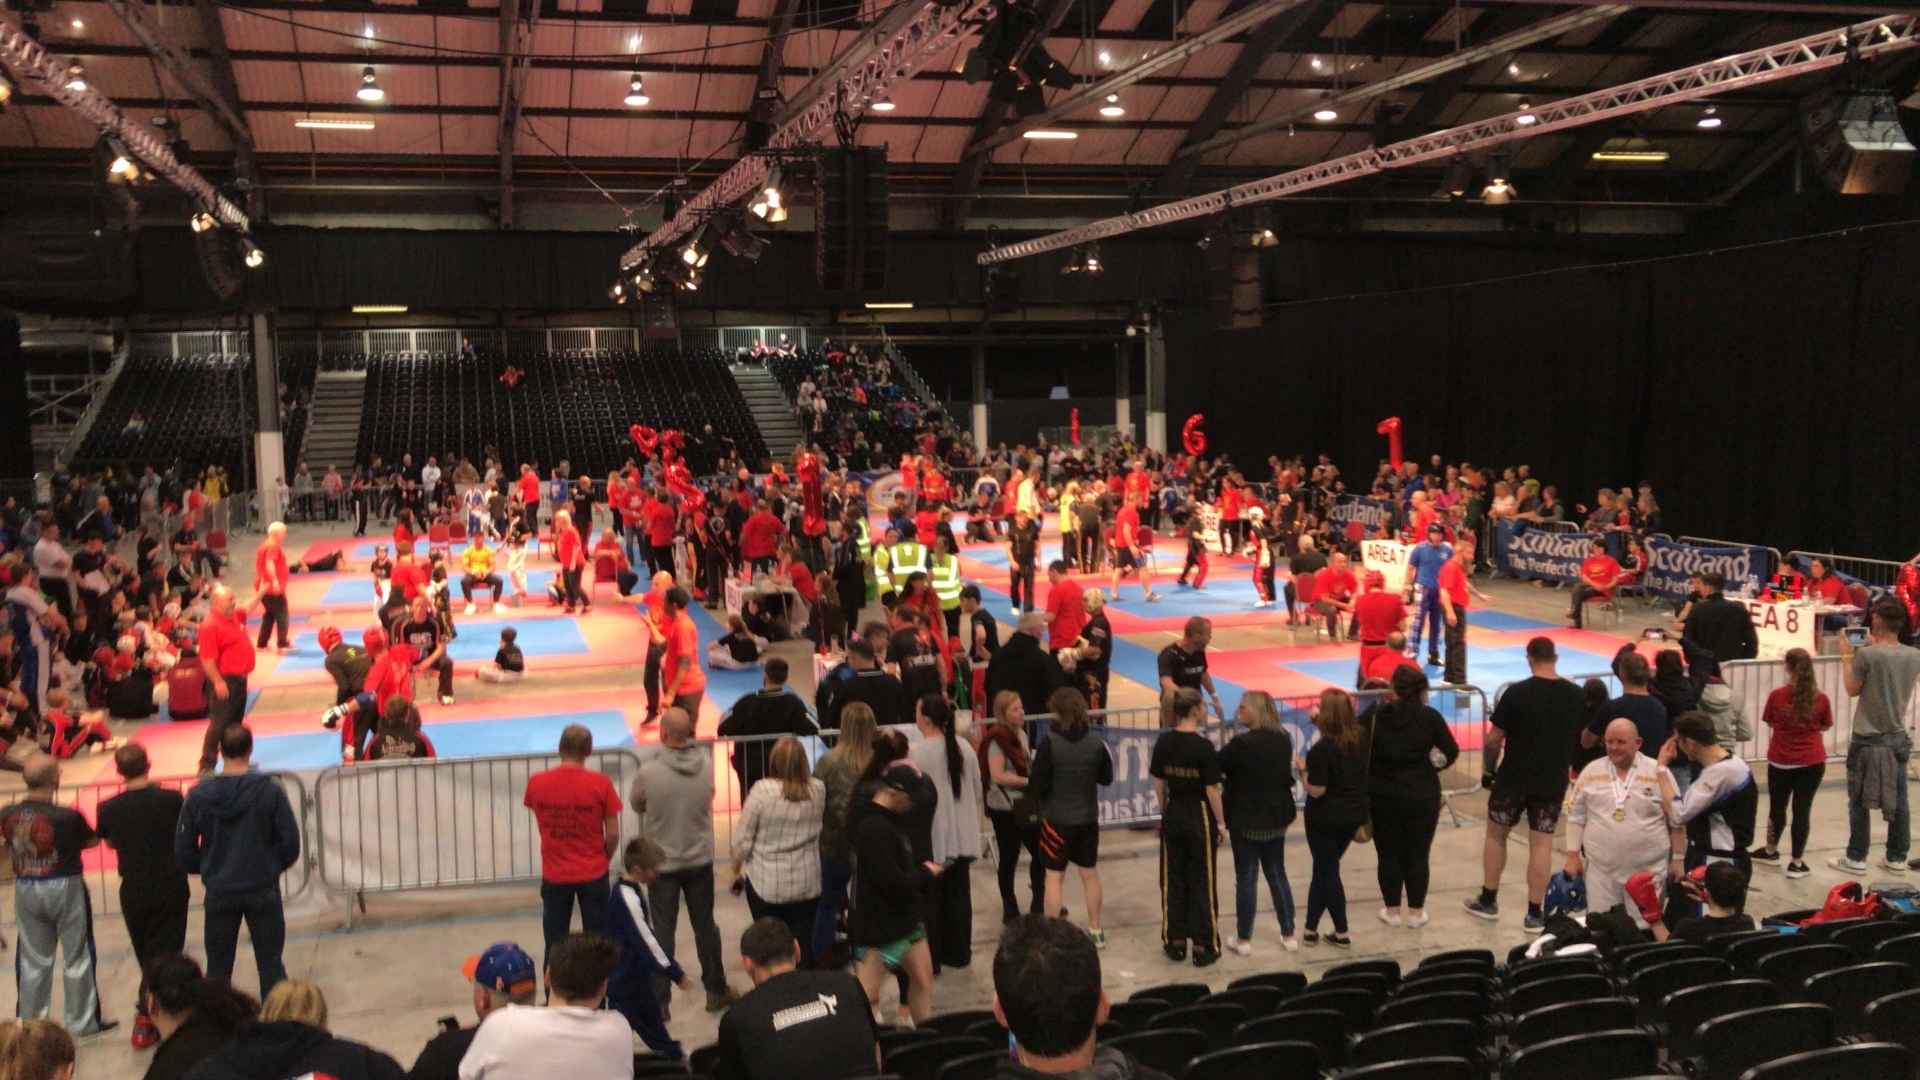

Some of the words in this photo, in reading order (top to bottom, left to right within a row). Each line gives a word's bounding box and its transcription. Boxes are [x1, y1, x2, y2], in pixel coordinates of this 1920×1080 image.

[1327, 497, 1386, 529] cotland
[1367, 543, 1398, 566] AREA
[1749, 602, 1780, 631] EA
[1786, 608, 1799, 634] 8
